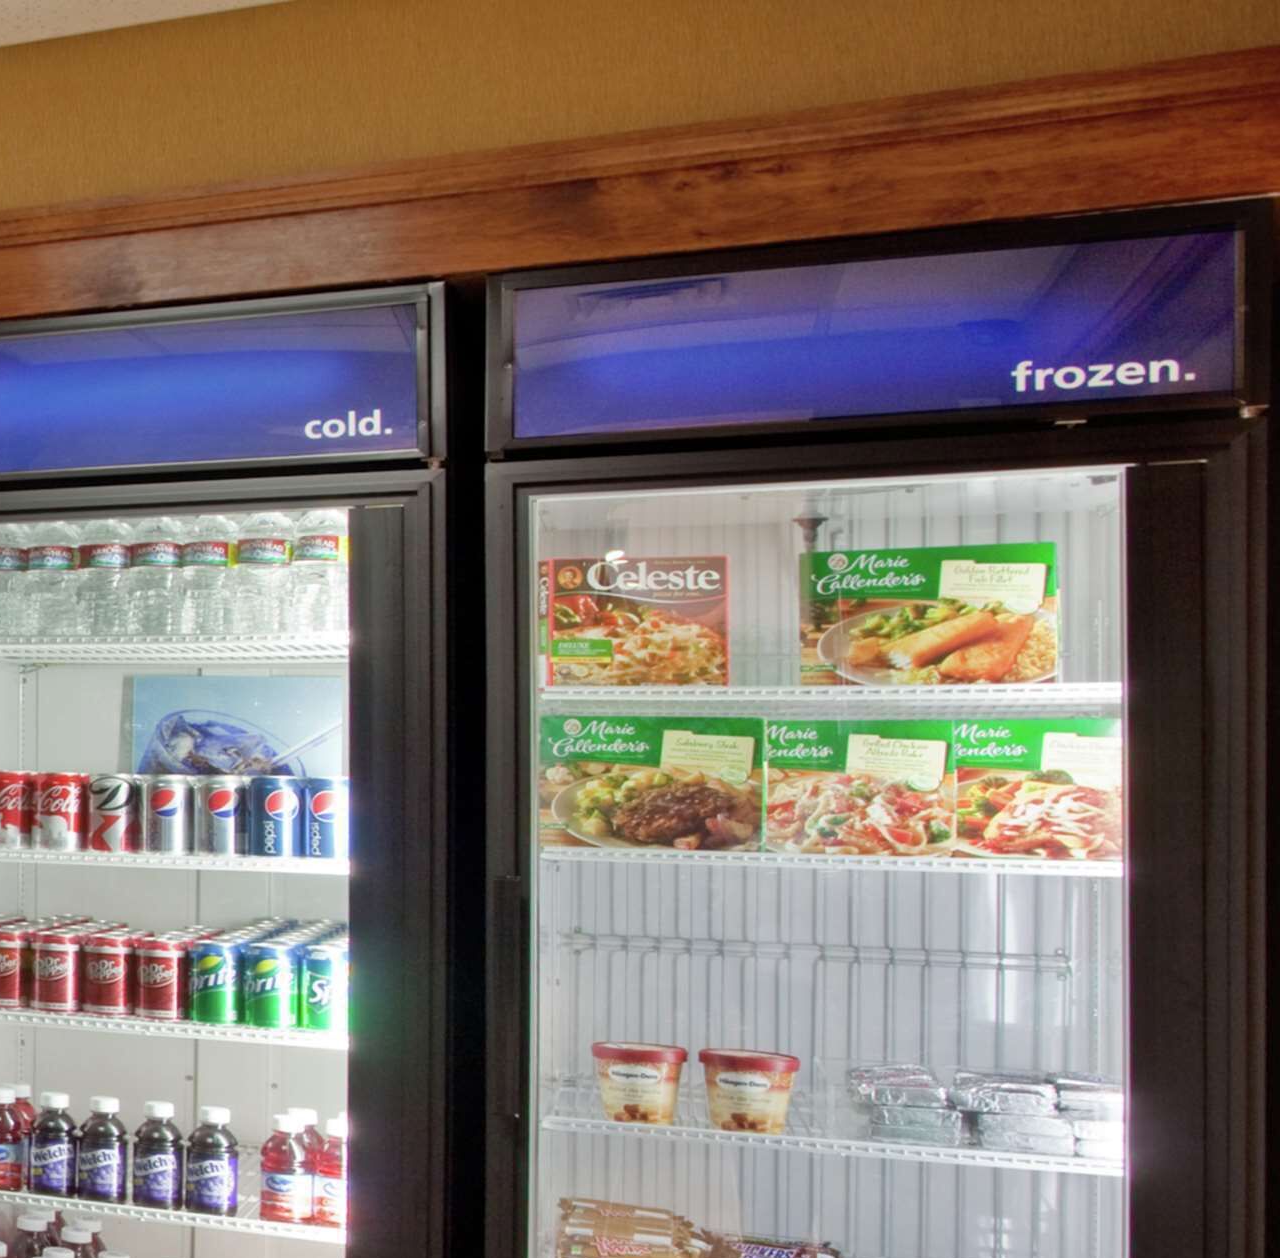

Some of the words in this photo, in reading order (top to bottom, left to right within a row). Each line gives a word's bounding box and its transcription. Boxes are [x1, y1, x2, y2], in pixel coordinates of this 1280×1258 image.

[1010, 358, 1197, 393] frozen.
[303, 408, 394, 440] cold.
[846, 553, 910, 575] Marie
[954, 565, 987, 576] Golden
[586, 560, 722, 592] Celeste
[810, 572, 927, 596] Callender's
[584, 718, 636, 739] Marie
[767, 724, 818, 744] Marie
[954, 722, 1012, 745] Marie
[548, 735, 650, 758] Callender's
[265, 820, 276, 855] pepsi
[312, 821, 323, 857] pepsi
[33, 1146, 73, 1162] Welch's
